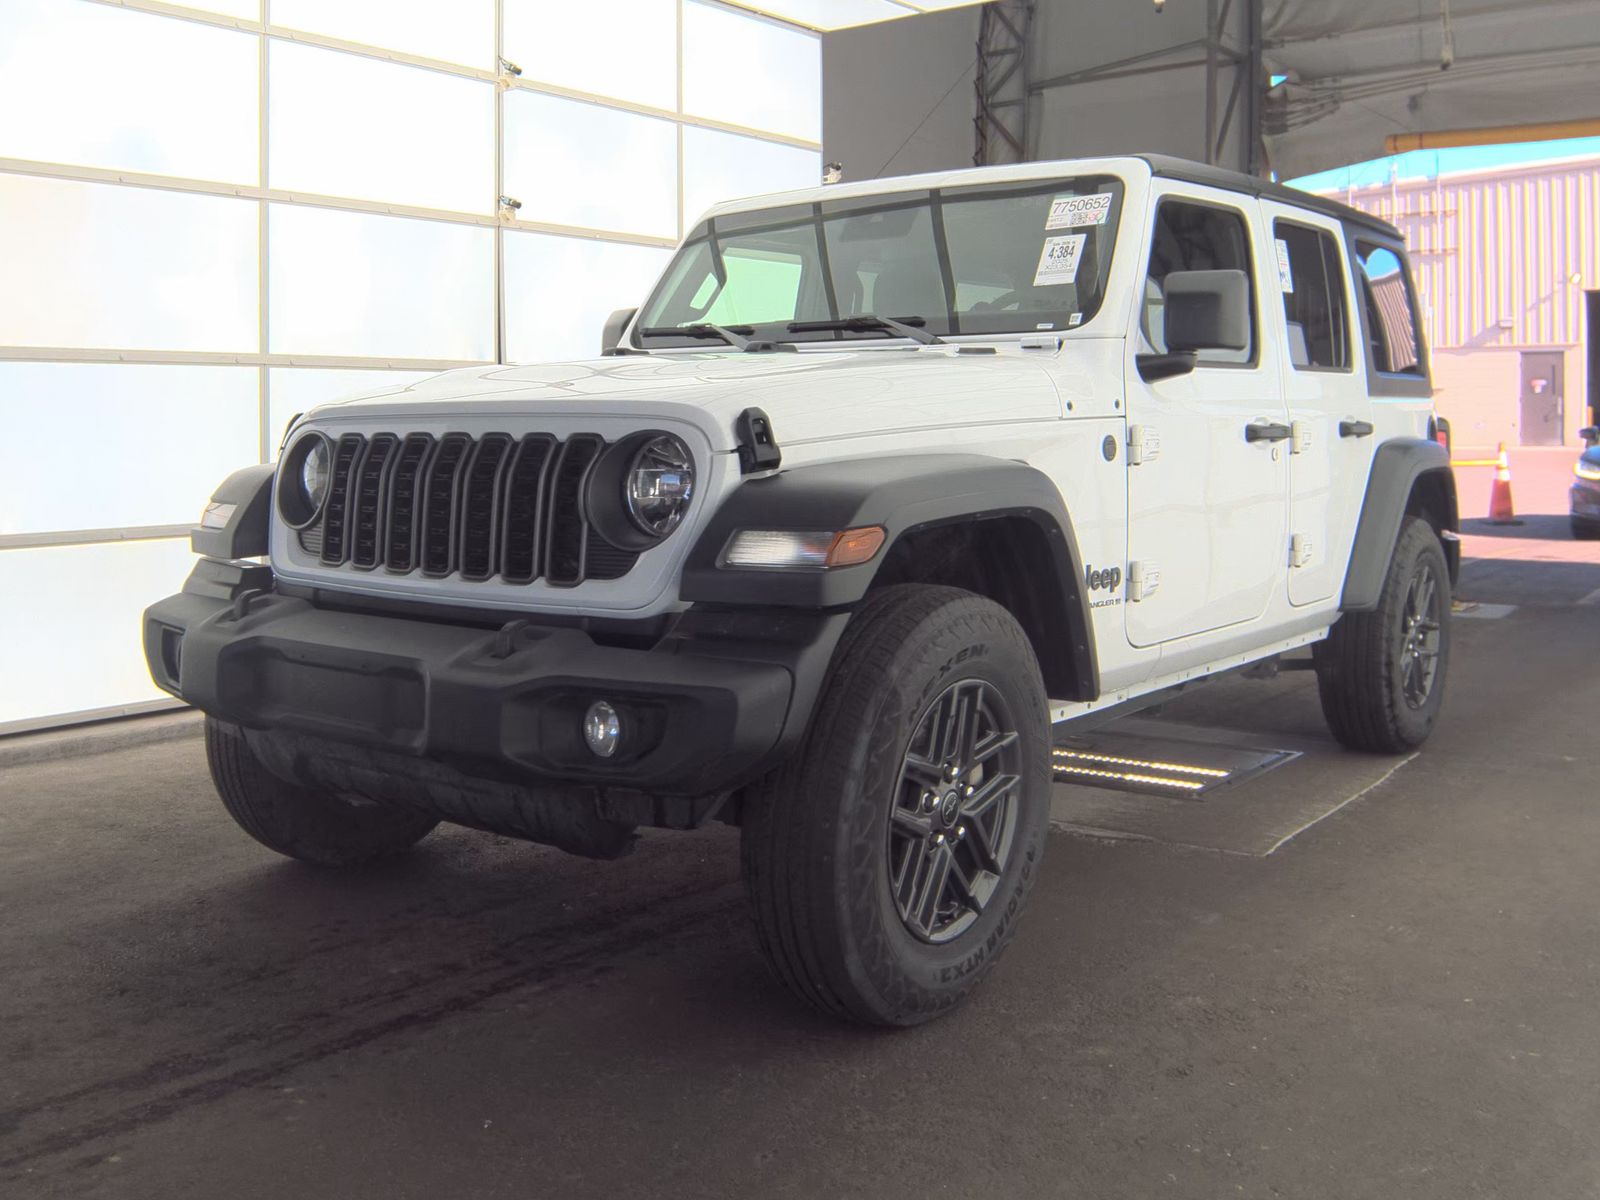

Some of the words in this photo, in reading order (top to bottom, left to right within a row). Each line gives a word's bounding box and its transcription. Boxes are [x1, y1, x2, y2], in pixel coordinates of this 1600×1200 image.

[1053, 196, 1111, 214] 7750652
[1048, 245, 1076, 260] 4:384
[1086, 564, 1121, 593] Jeep
